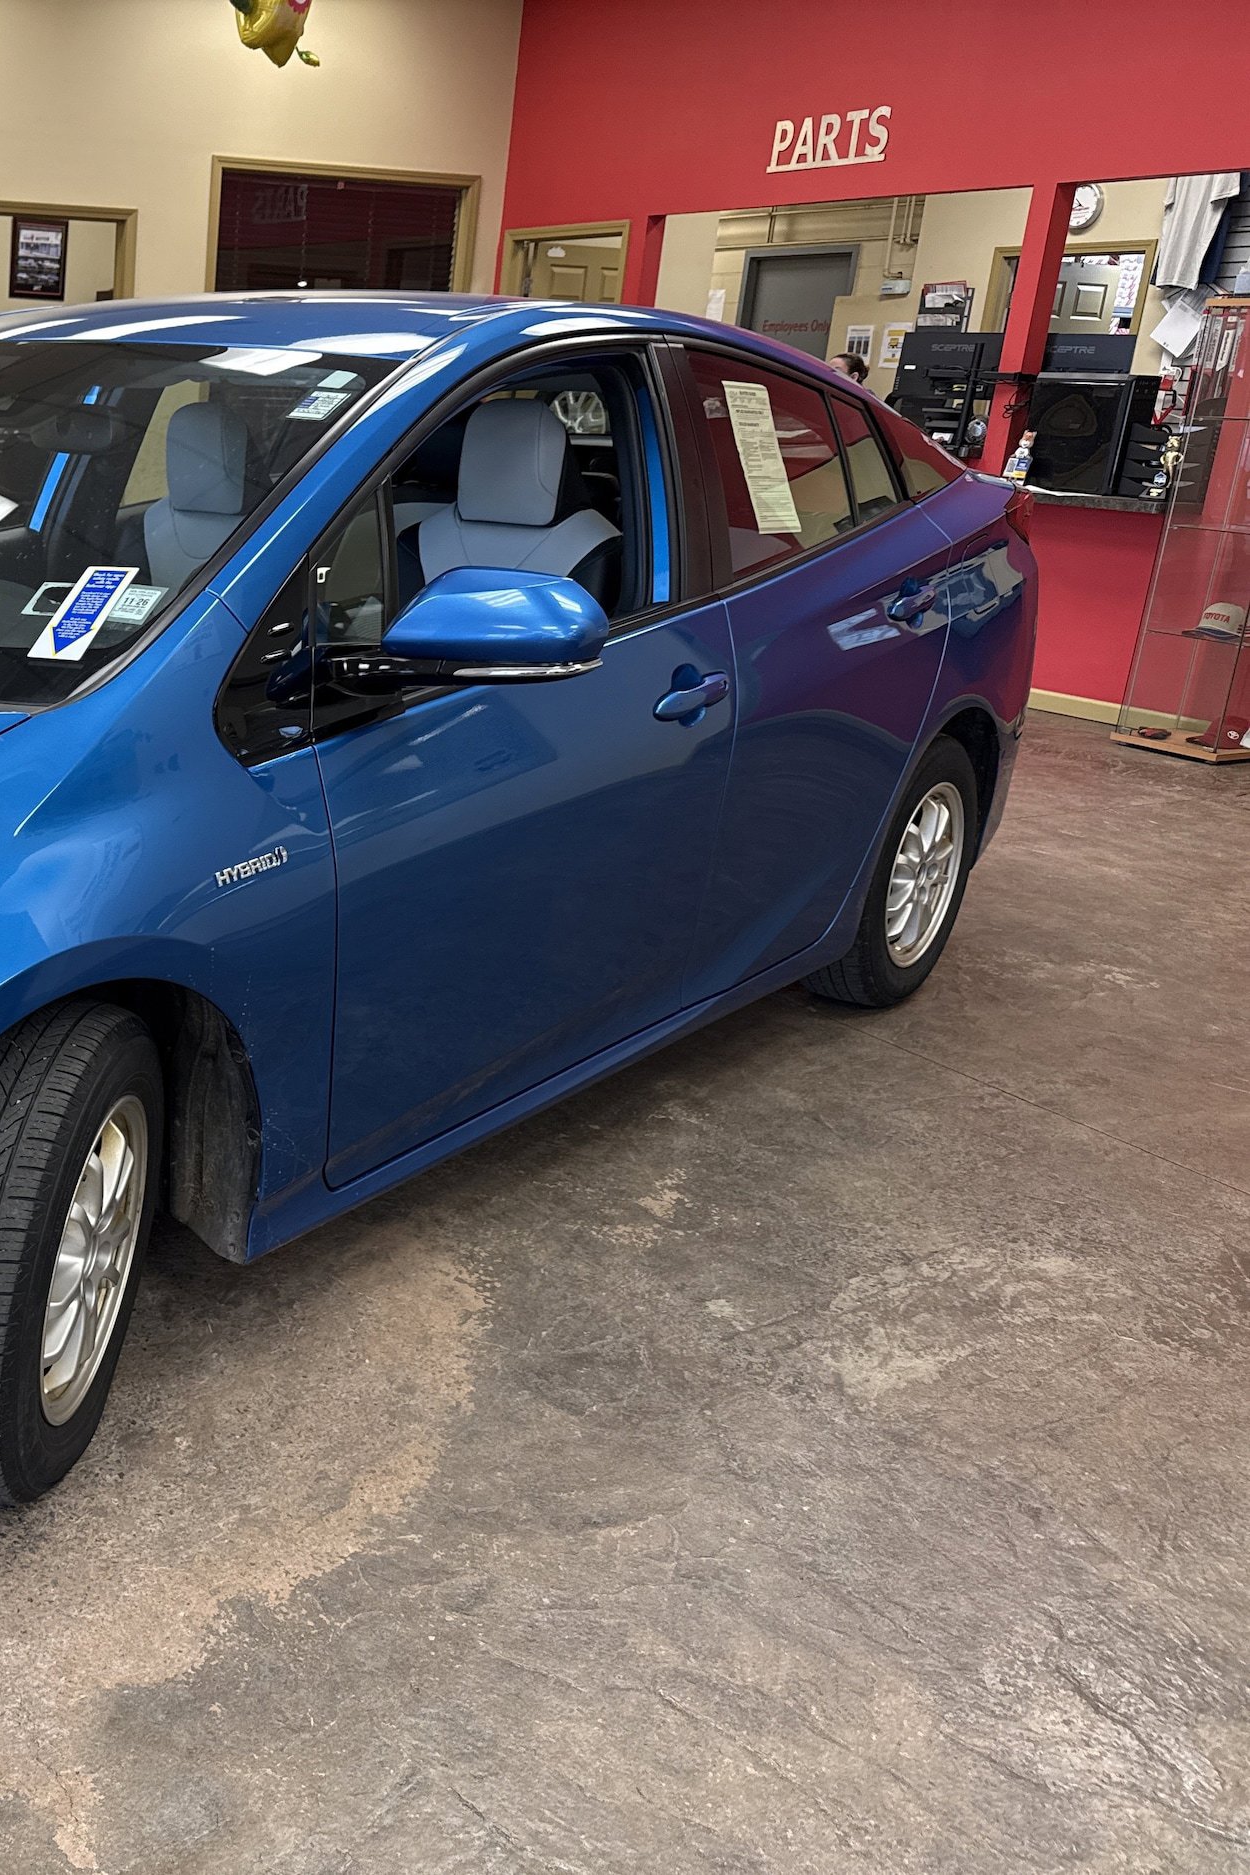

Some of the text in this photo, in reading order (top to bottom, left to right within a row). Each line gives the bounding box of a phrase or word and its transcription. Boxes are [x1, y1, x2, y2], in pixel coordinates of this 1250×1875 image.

[767, 105, 891, 171] PARTS
[762, 319, 830, 335] Employees Only
[931, 343, 976, 352] SCEPTRE
[123, 597, 135, 605] 11
[1204, 612, 1231, 624] TOYOTA
[215, 848, 283, 888] HYBRID
